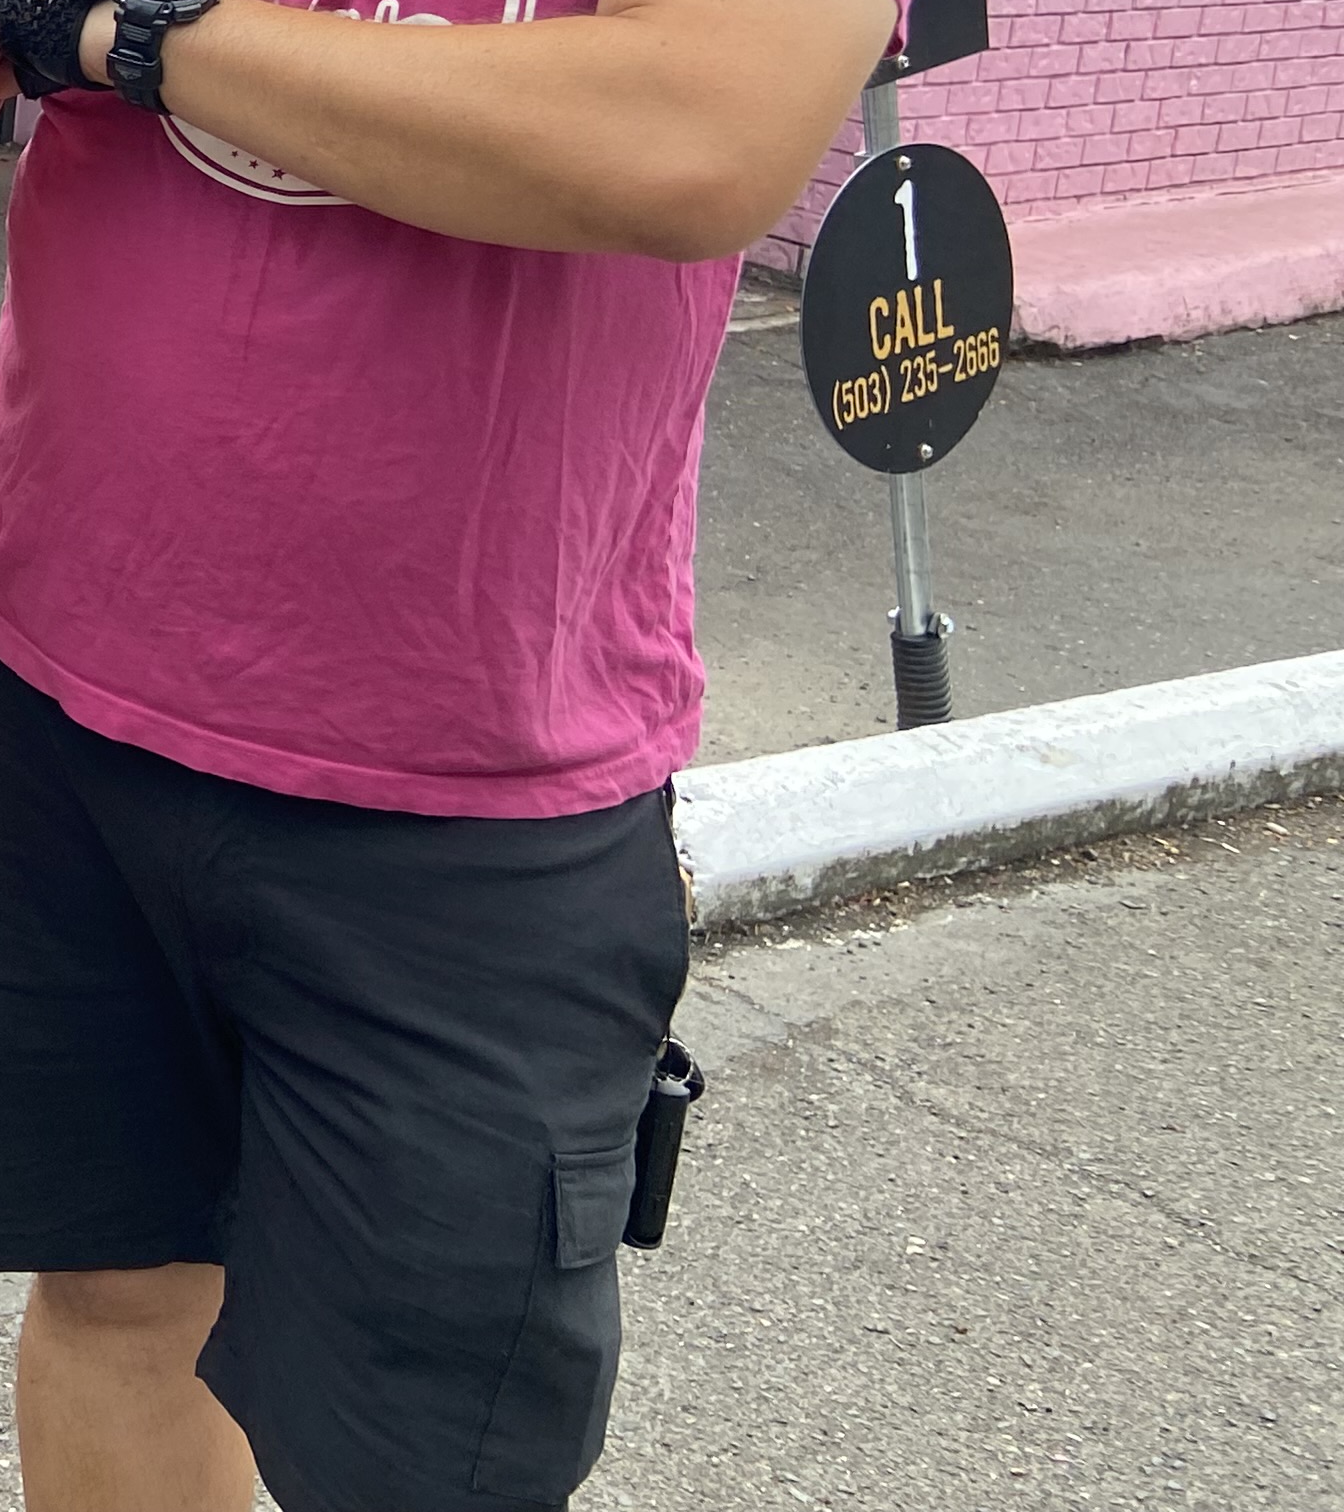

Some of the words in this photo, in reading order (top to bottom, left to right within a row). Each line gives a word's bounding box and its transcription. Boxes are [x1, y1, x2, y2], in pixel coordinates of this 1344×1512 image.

[894, 179, 918, 281] 1
[869, 278, 955, 361] CALL
[832, 365, 892, 430] (503)
[900, 326, 1001, 403] 235-2666
